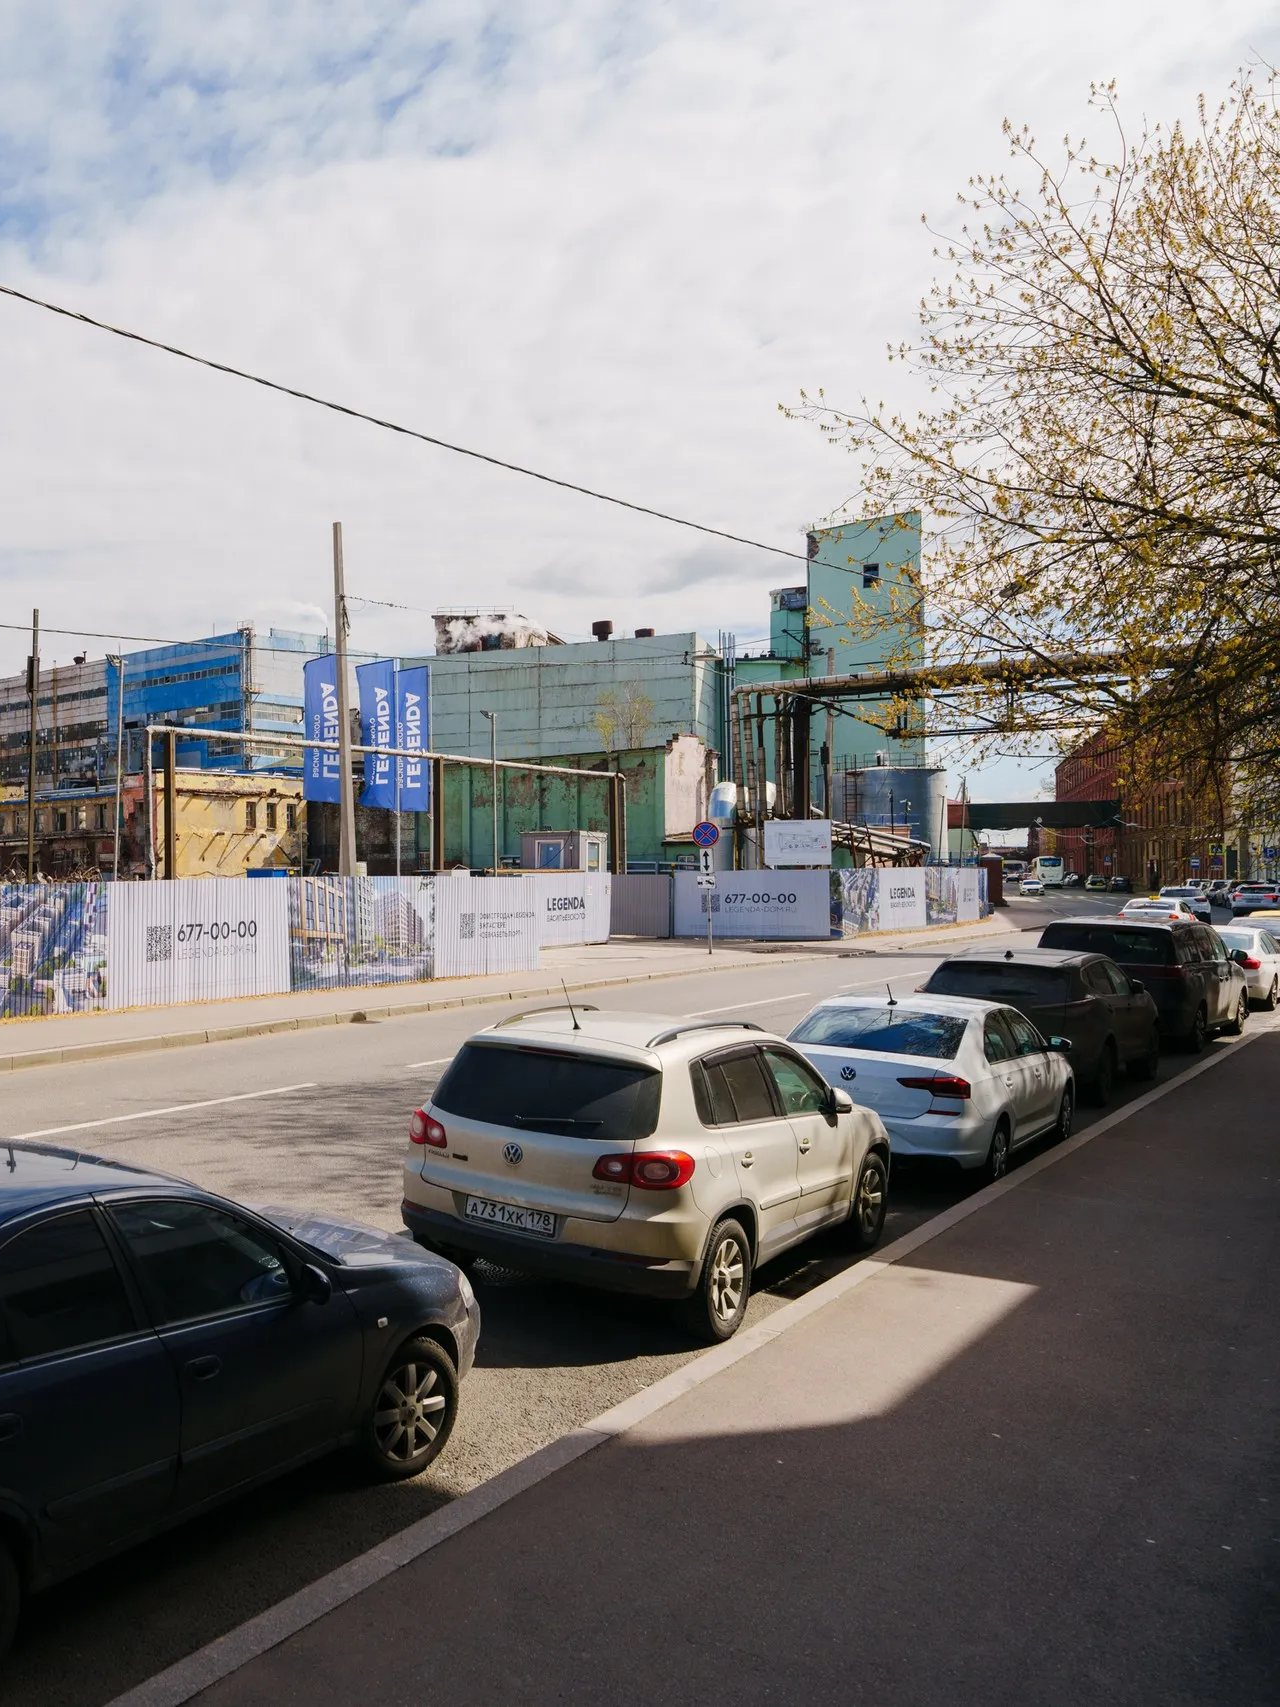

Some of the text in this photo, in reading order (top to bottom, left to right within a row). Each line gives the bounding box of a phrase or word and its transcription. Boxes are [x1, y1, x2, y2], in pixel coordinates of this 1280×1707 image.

[724, 893, 797, 904] 677-00-00
[889, 887, 915, 899] LEGENDA
[547, 897, 585, 911] LEGENDA
[177, 920, 257, 942] 677-00-00
[528, 1211, 552, 1227] 178
